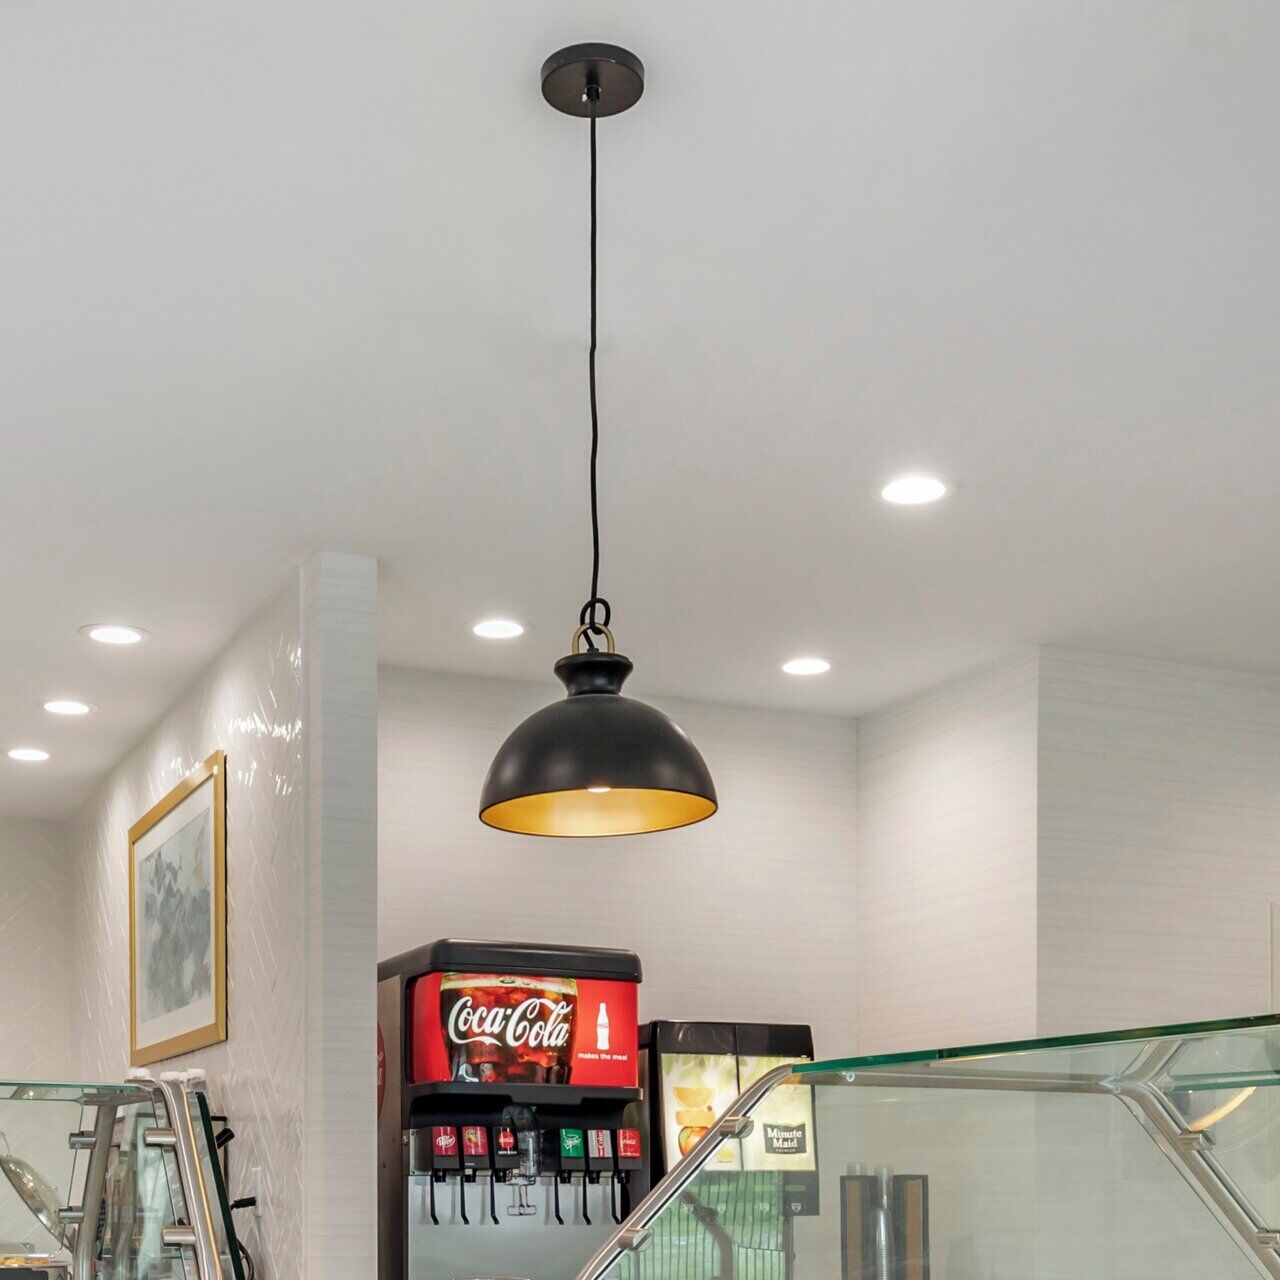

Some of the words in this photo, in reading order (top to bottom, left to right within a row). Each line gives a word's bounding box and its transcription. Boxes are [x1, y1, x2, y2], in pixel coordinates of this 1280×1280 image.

[448, 996, 573, 1048] Coca-Cola
[767, 1128, 802, 1138] Minute
[772, 1137, 798, 1148] Maid
